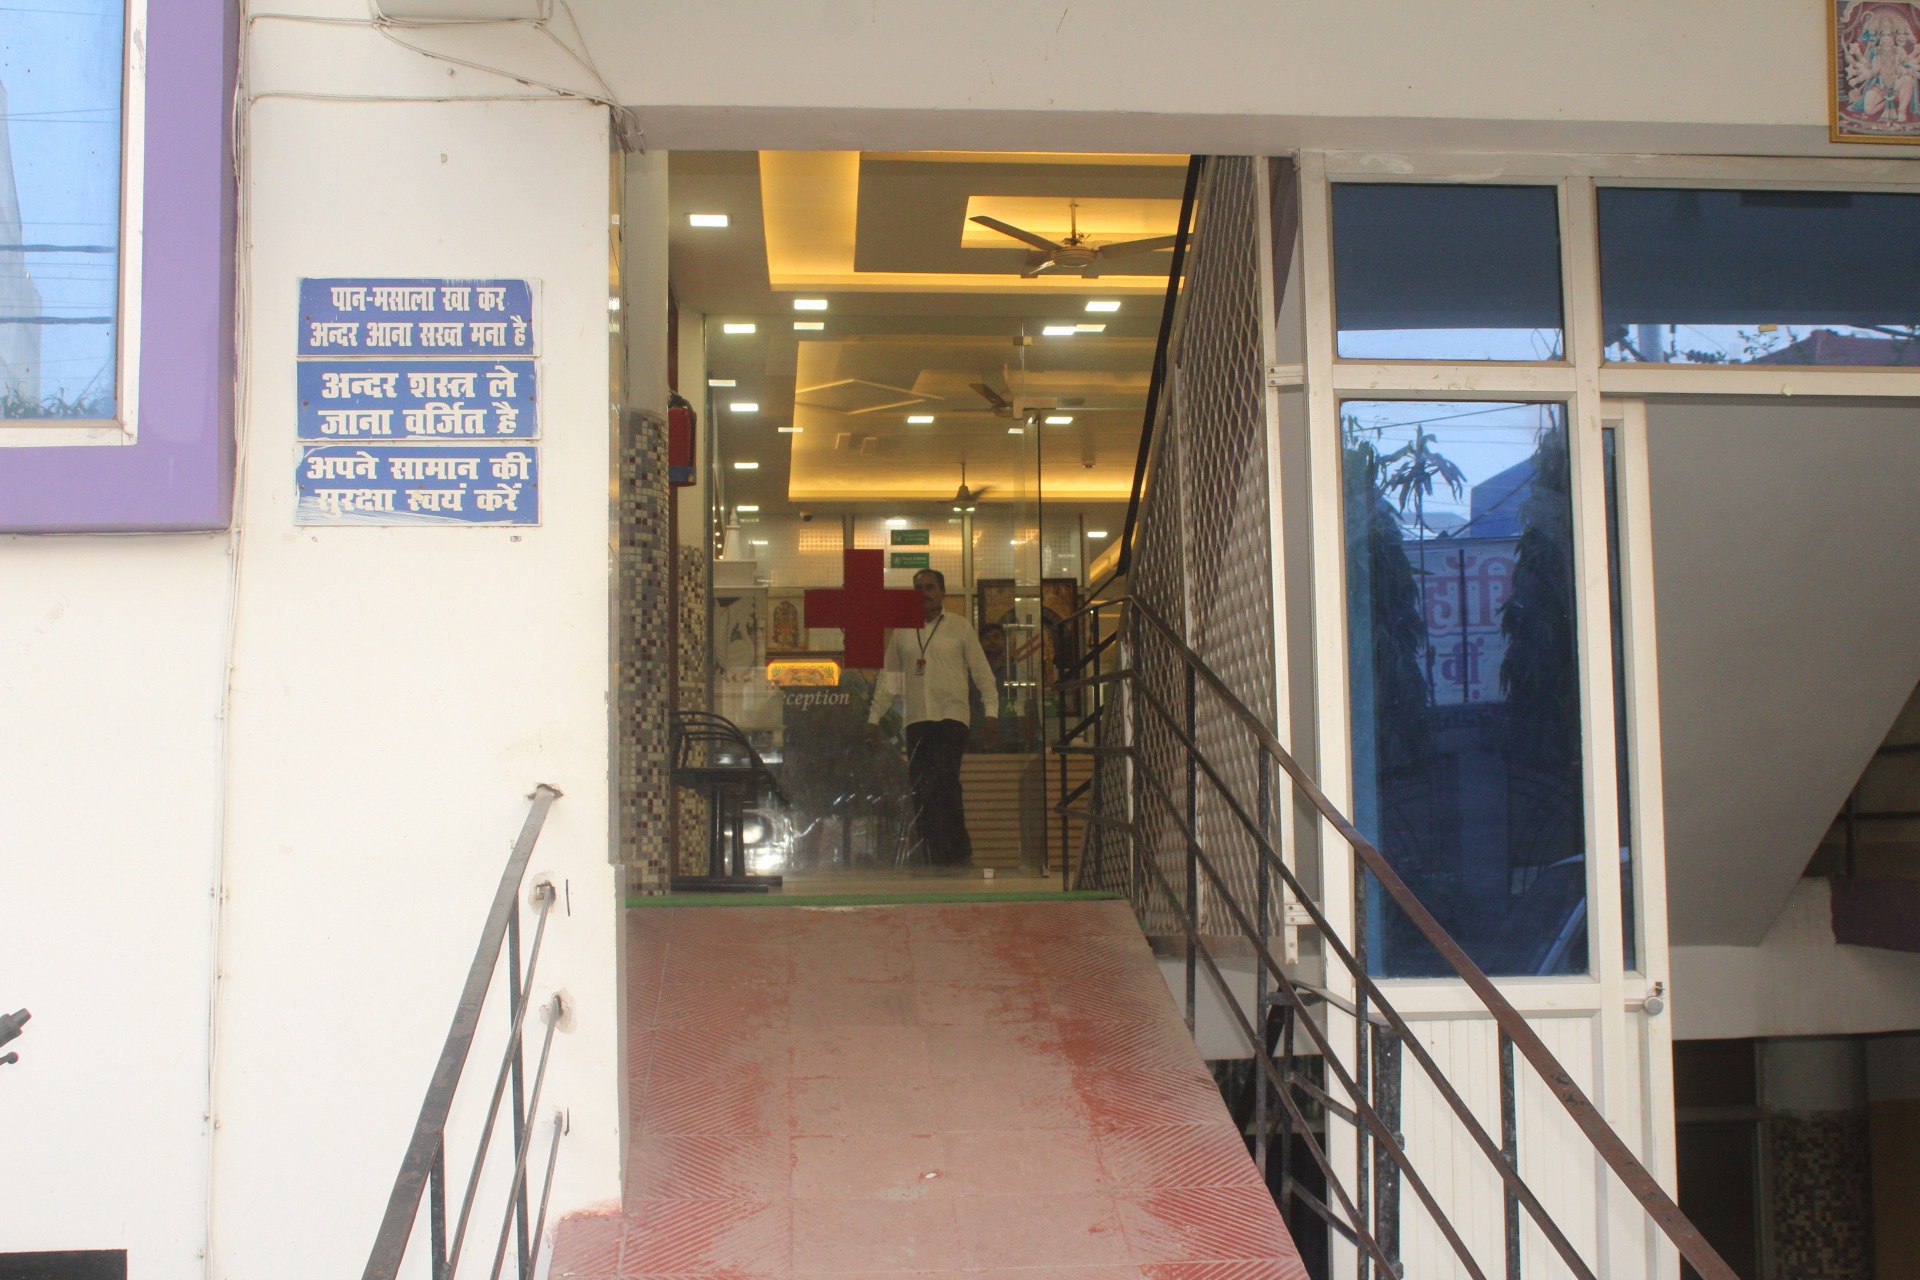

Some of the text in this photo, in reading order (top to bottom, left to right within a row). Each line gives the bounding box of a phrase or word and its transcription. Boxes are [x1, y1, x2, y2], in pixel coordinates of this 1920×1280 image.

[331, 287, 506, 312] पान-मसाला खा कर
[310, 315, 527, 347] अन्दर आना सख्त मना है
[321, 373, 399, 398] अन्दर
[486, 365, 518, 398] ले
[318, 402, 519, 435] जाना वर्जित है
[306, 451, 532, 479] अपने सामान की
[315, 483, 522, 519] सुरक्षा स्वयं करें
